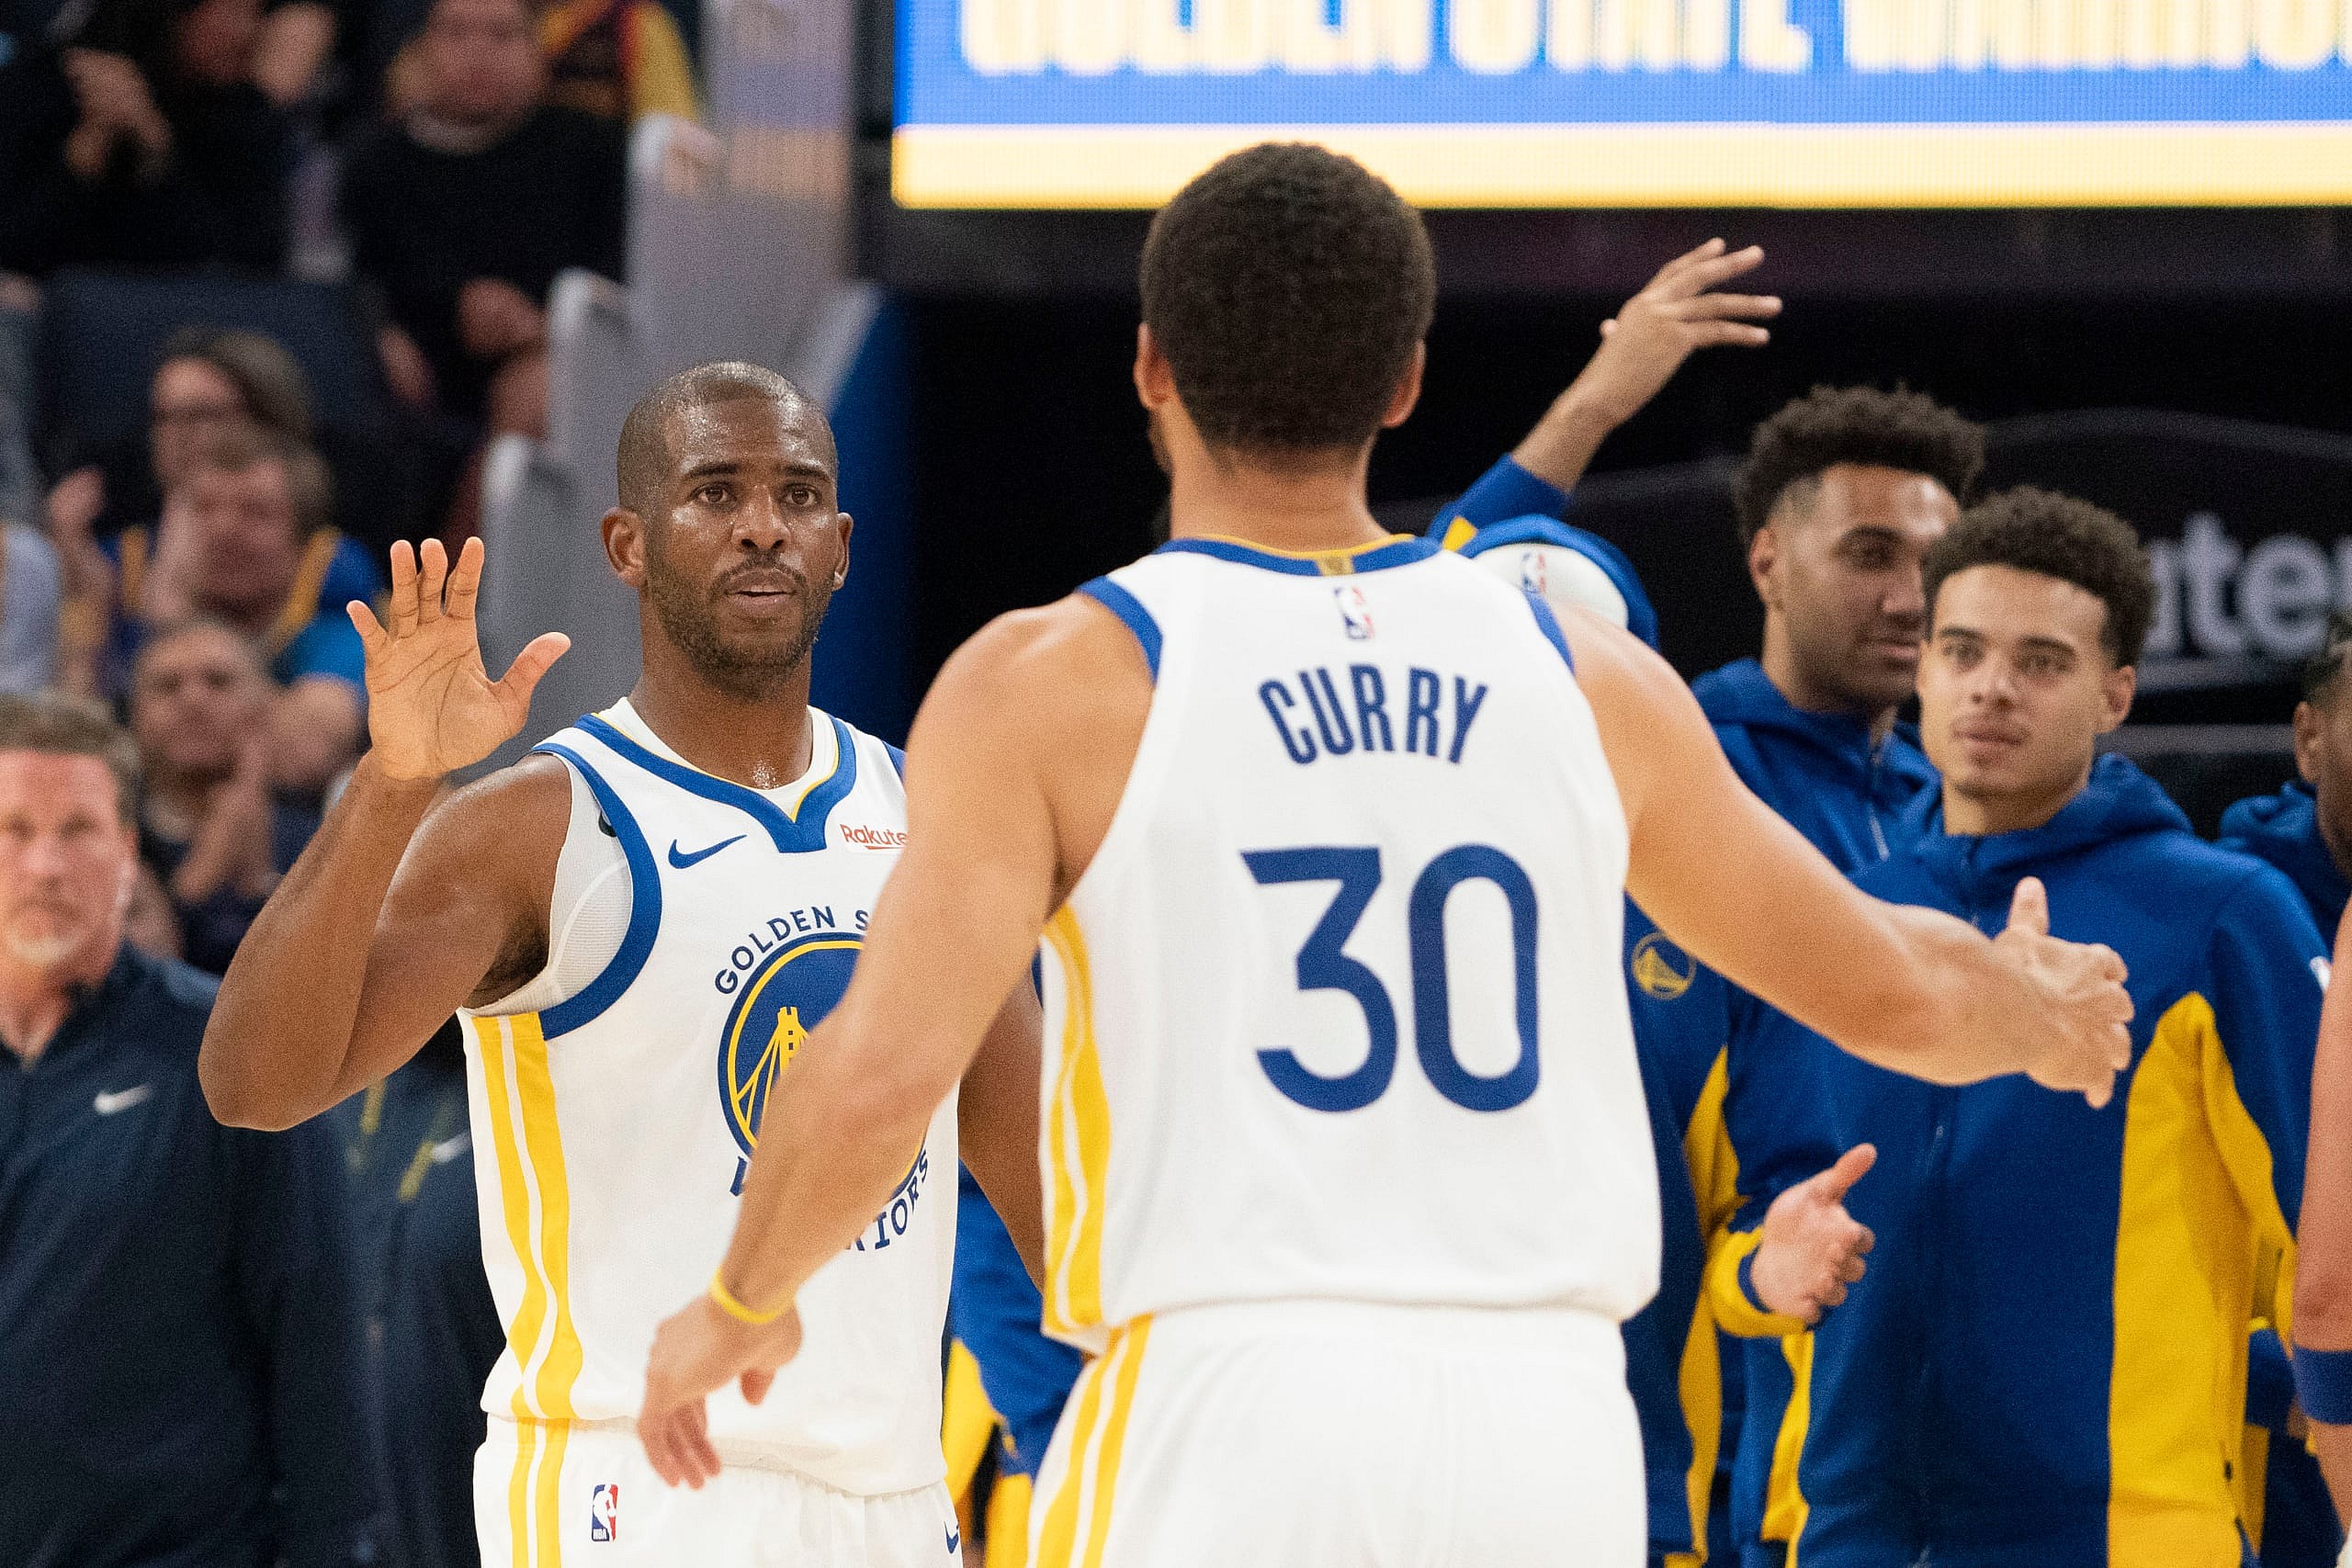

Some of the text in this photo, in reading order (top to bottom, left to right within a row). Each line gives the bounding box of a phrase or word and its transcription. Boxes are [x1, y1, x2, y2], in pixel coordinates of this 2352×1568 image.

[1259, 665, 1487, 764] CURRY
[839, 824, 909, 847] Rakute
[715, 906, 835, 994] GOLDEN
[1241, 844, 1540, 1112] 30
